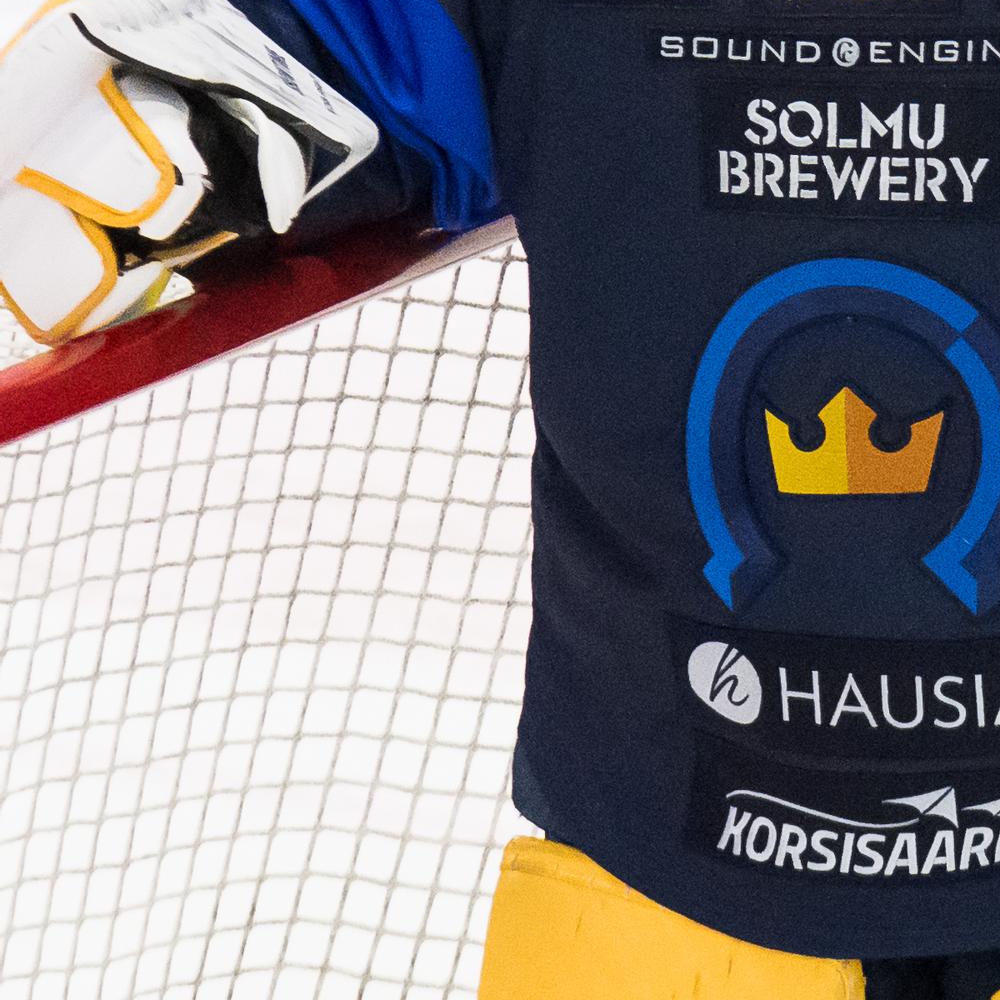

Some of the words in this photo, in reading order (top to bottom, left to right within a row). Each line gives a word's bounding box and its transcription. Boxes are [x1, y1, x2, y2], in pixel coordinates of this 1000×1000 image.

[660, 36, 821, 63] SOUND
[744, 98, 946, 150] SOLMU
[718, 150, 990, 203] BREWERY
